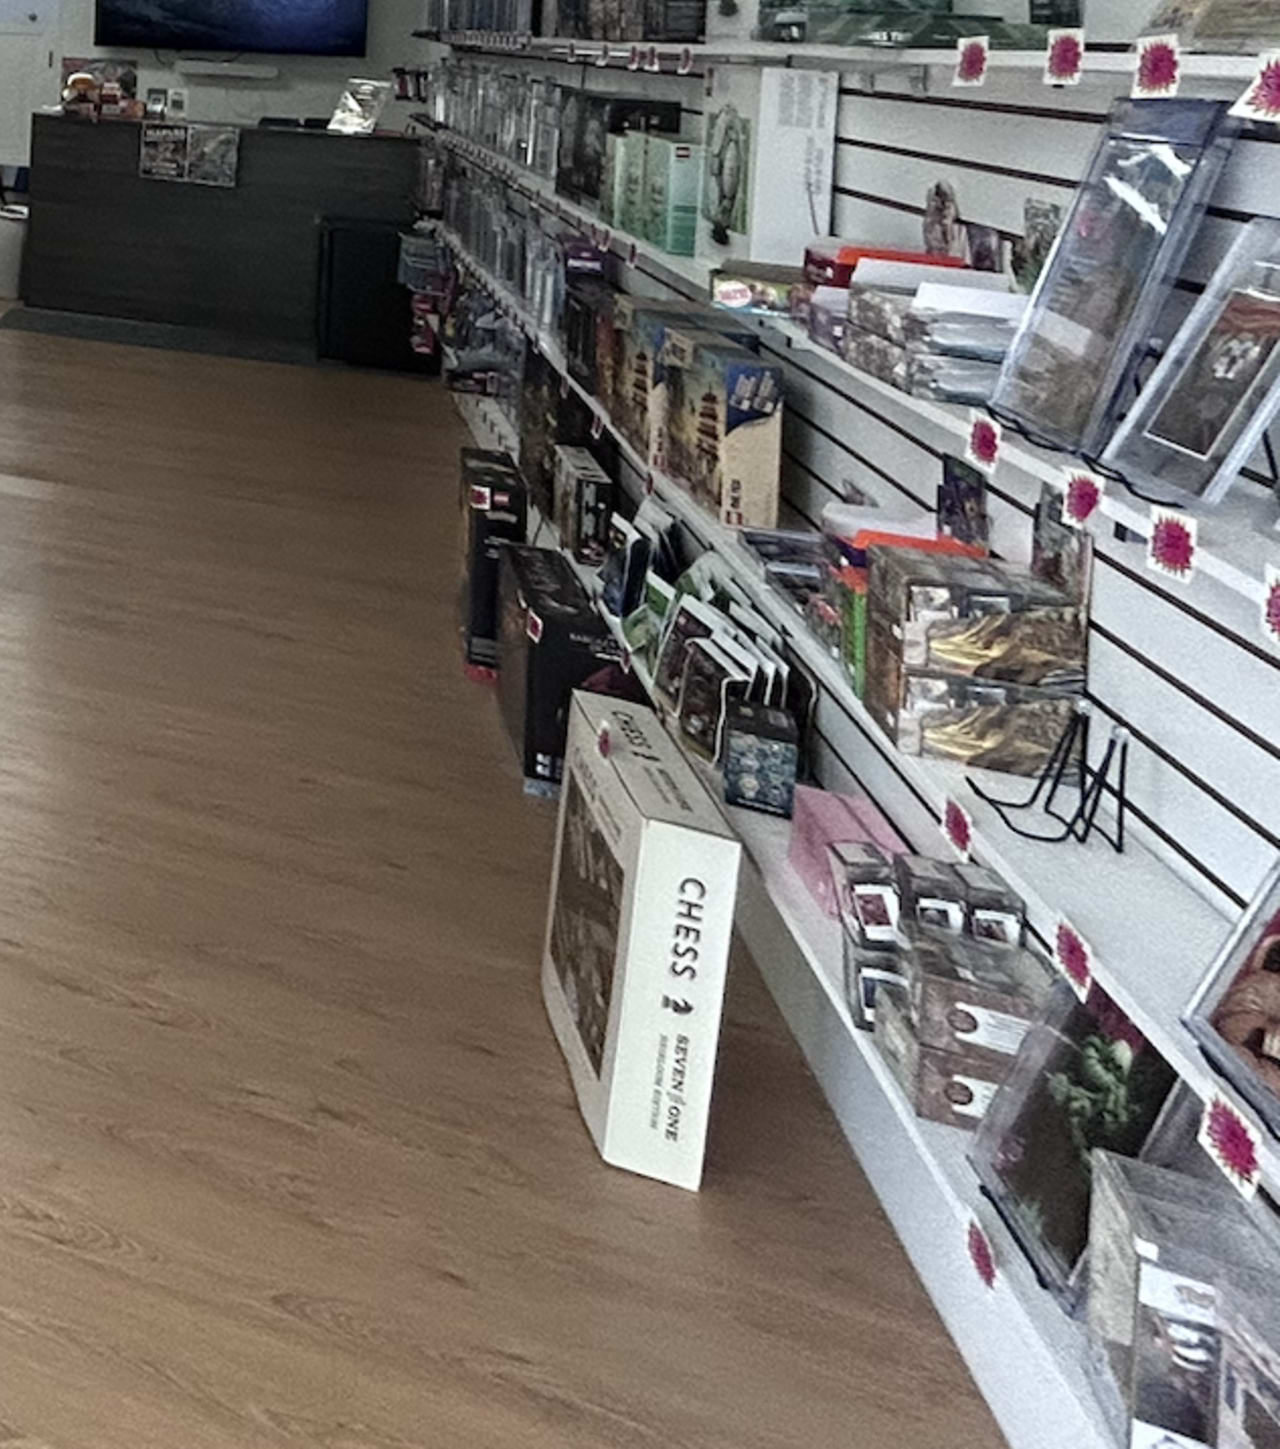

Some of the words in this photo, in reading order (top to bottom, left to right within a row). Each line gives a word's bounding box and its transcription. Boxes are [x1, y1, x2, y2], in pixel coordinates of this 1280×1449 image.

[671, 877, 706, 981] CHESS
[672, 1034, 689, 1092] SEVEN
[665, 1105, 681, 1142] ONE
